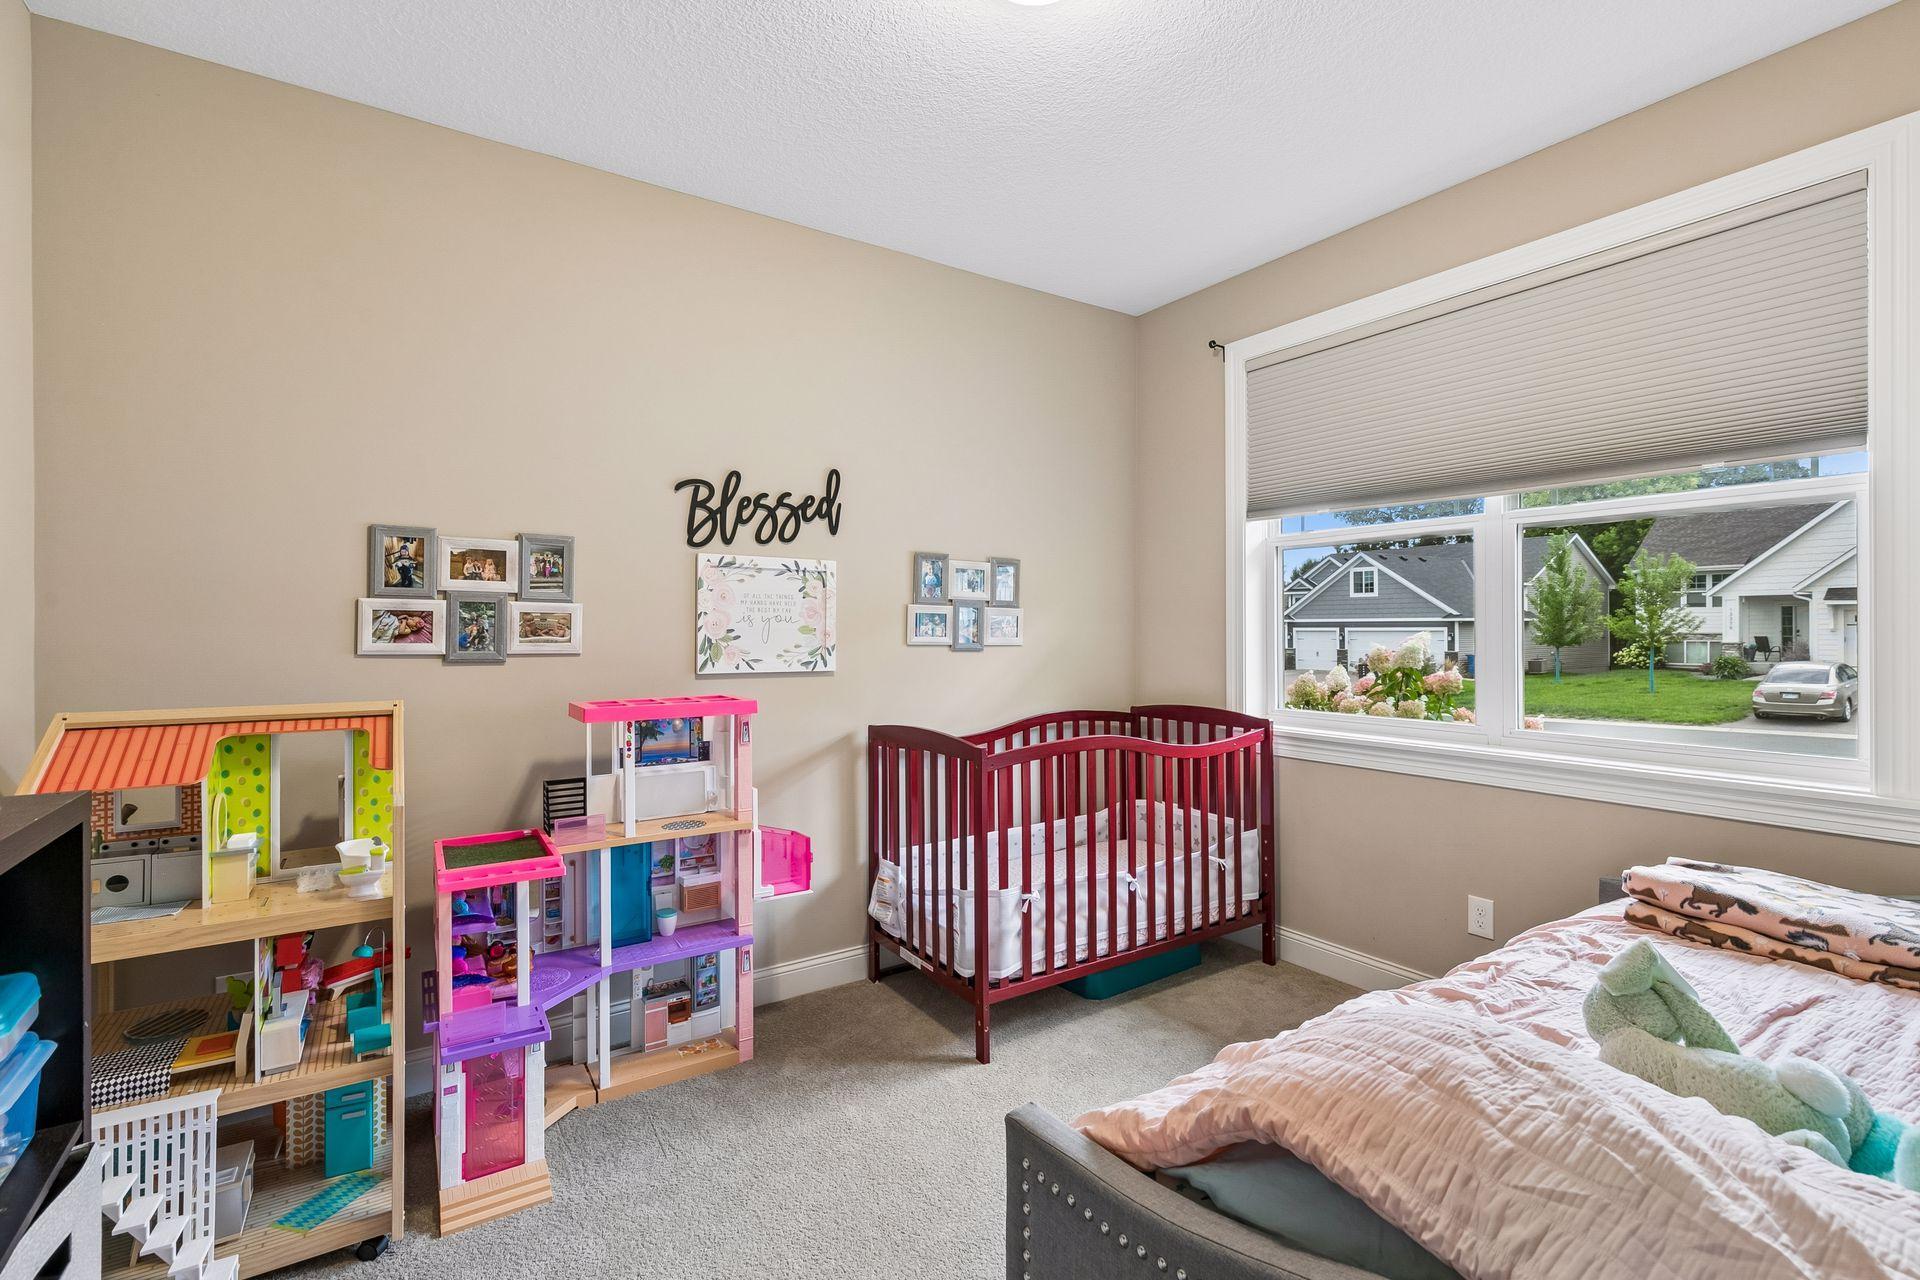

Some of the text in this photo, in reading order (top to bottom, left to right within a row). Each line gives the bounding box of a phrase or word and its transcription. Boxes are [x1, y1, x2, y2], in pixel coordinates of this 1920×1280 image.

[674, 468, 842, 548] Blessed
[736, 611, 800, 645] is you
